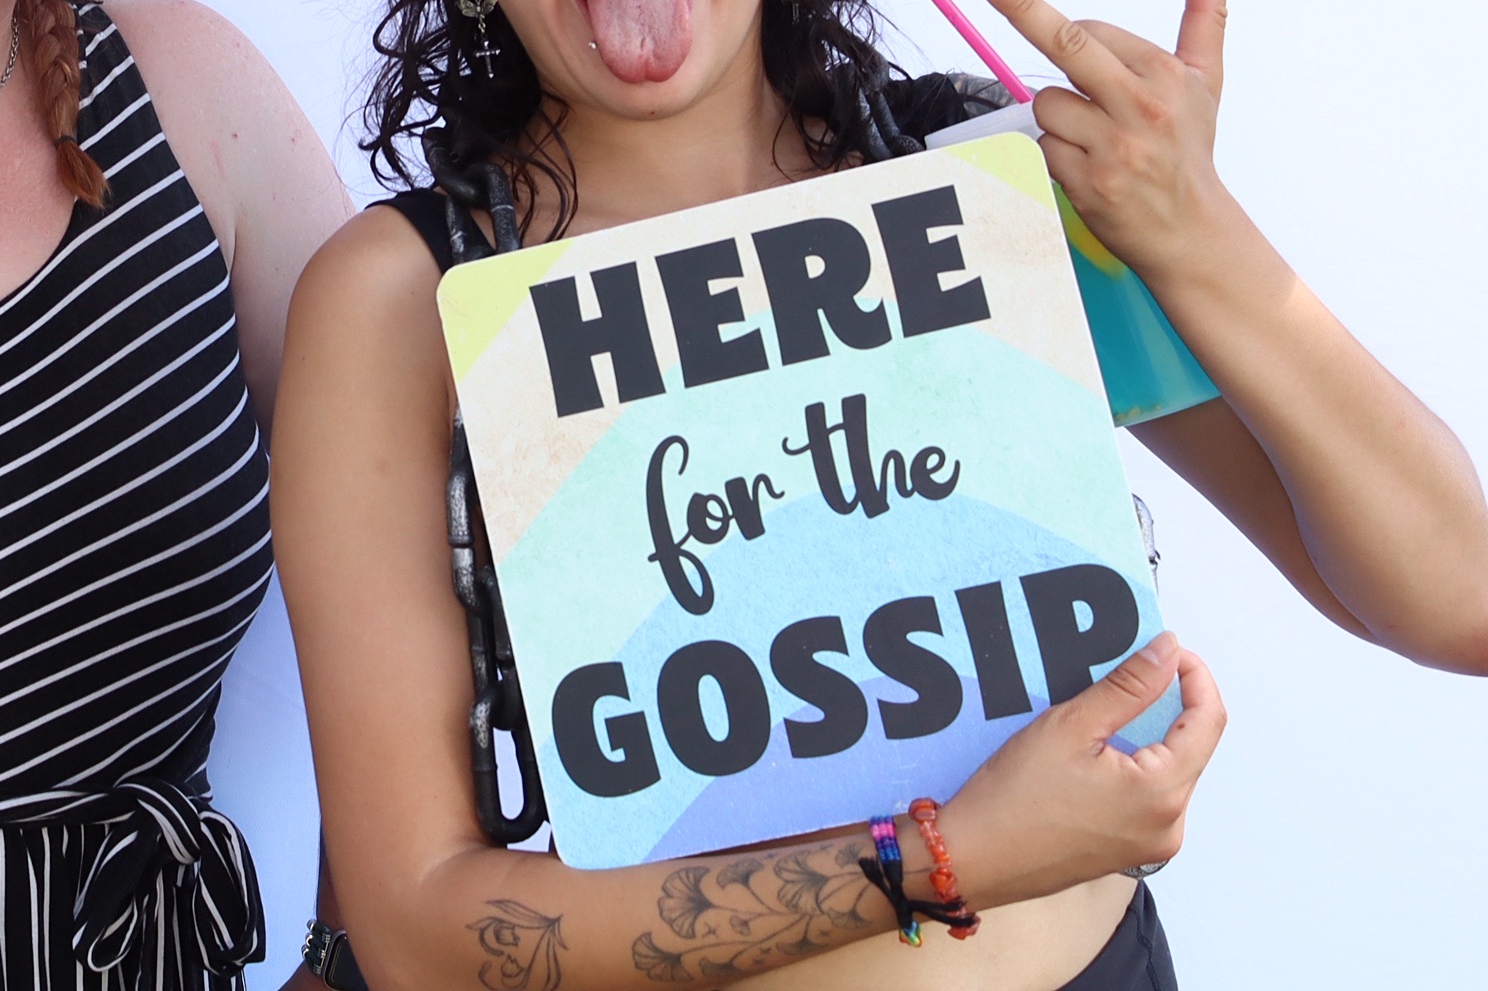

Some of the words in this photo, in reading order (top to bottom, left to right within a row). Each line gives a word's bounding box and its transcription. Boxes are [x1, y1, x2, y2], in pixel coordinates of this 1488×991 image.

[529, 185, 991, 418] HERE
[645, 434, 784, 615] for
[782, 393, 960, 519] the
[551, 562, 1140, 799] GOSSIP
